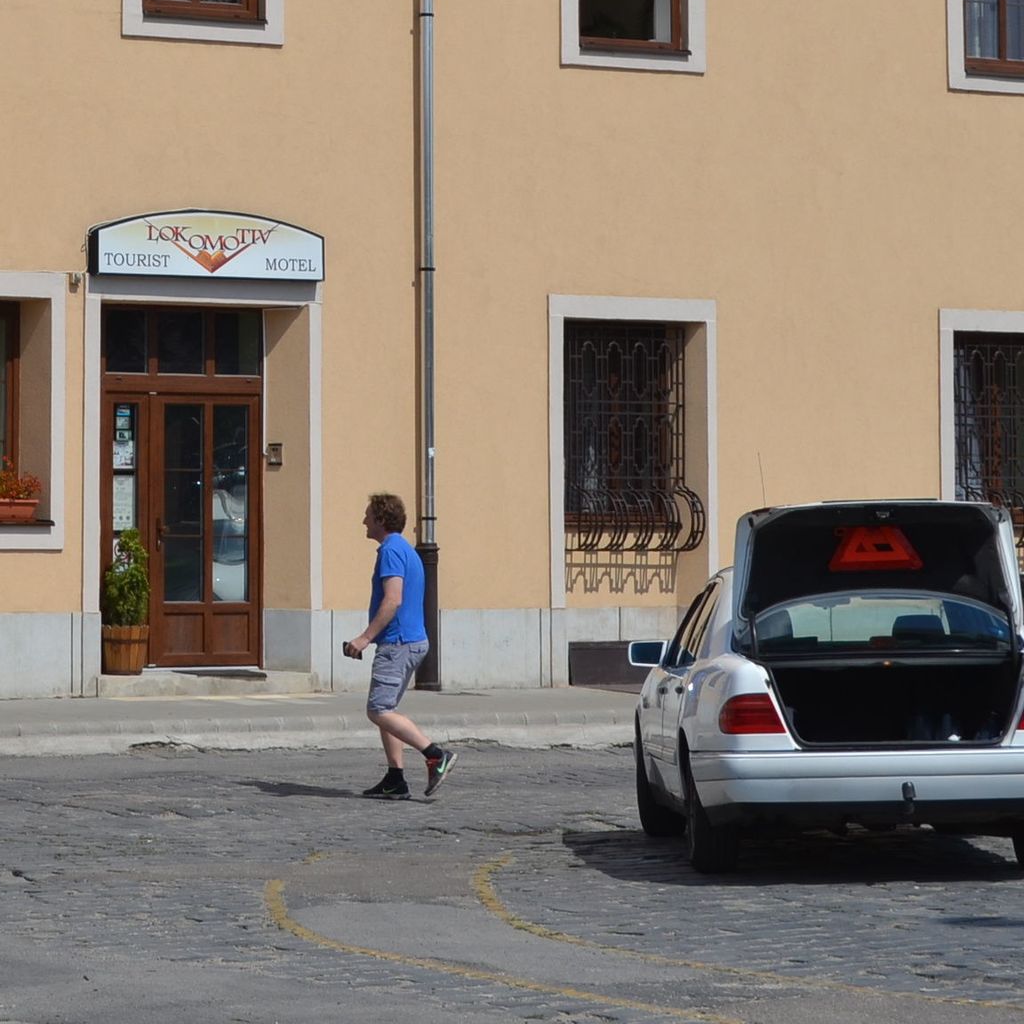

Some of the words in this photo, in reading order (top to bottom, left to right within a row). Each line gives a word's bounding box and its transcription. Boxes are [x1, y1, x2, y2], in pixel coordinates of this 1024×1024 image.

[146, 224, 273, 252] LOKOMOTIV
[104, 252, 170, 268] TOURIST
[265, 257, 317, 273] MOTEL
